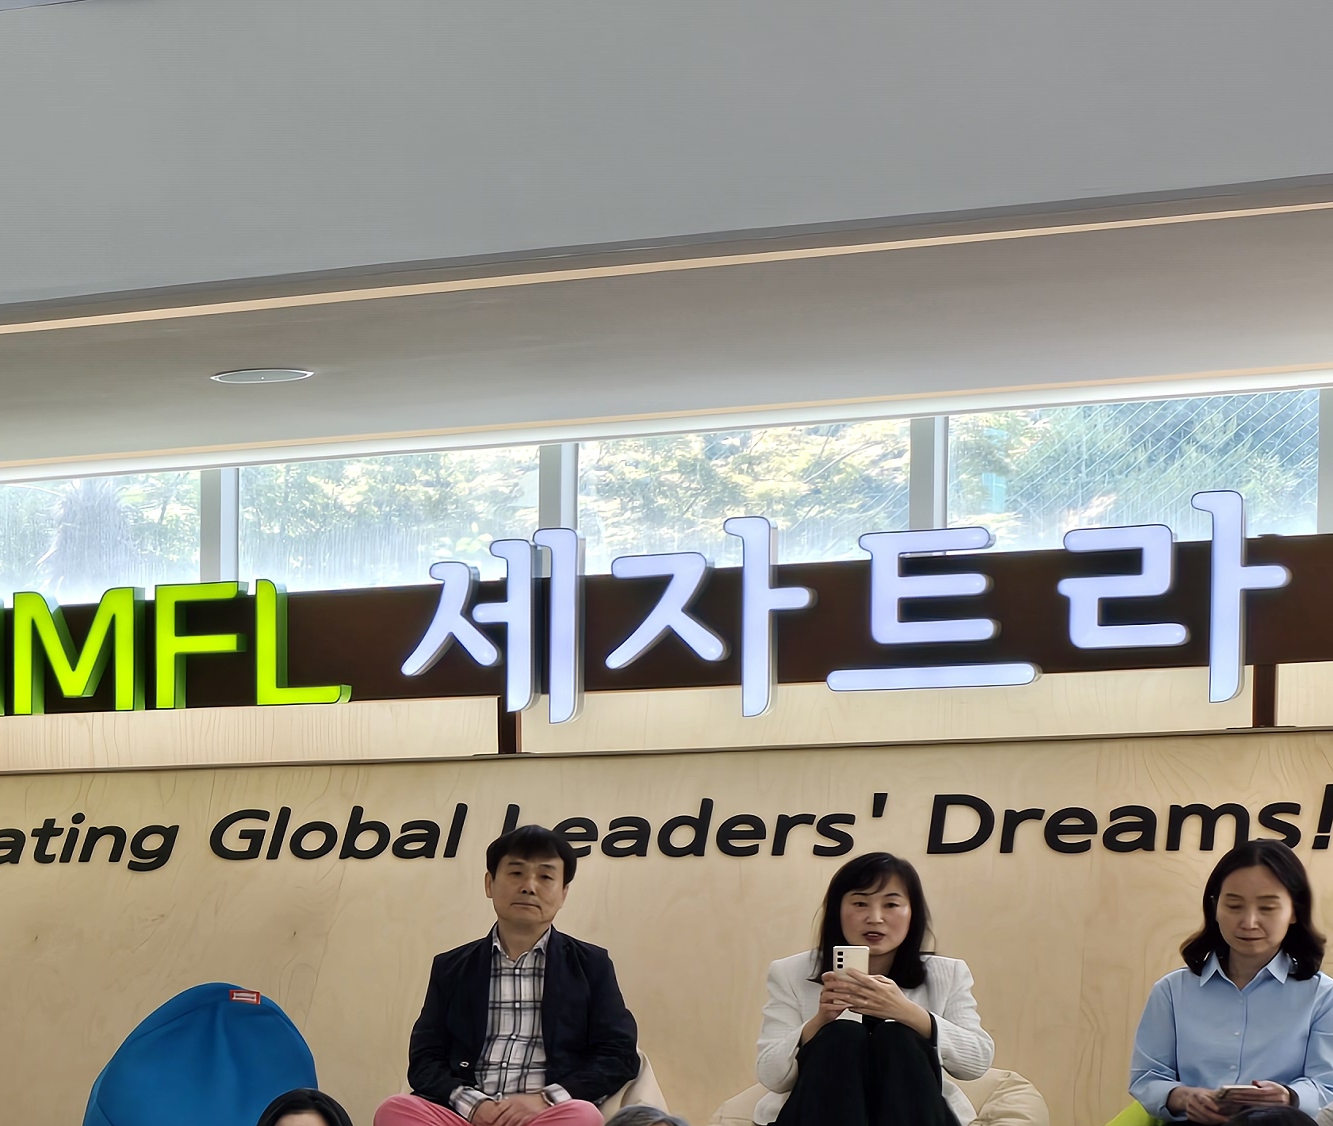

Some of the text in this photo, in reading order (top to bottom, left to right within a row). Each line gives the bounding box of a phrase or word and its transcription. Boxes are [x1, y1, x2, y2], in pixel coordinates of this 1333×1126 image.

[400, 490, 1291, 725] 세자트라
[210, 802, 468, 862] Global
[924, 783, 1333, 855] Dreams!
